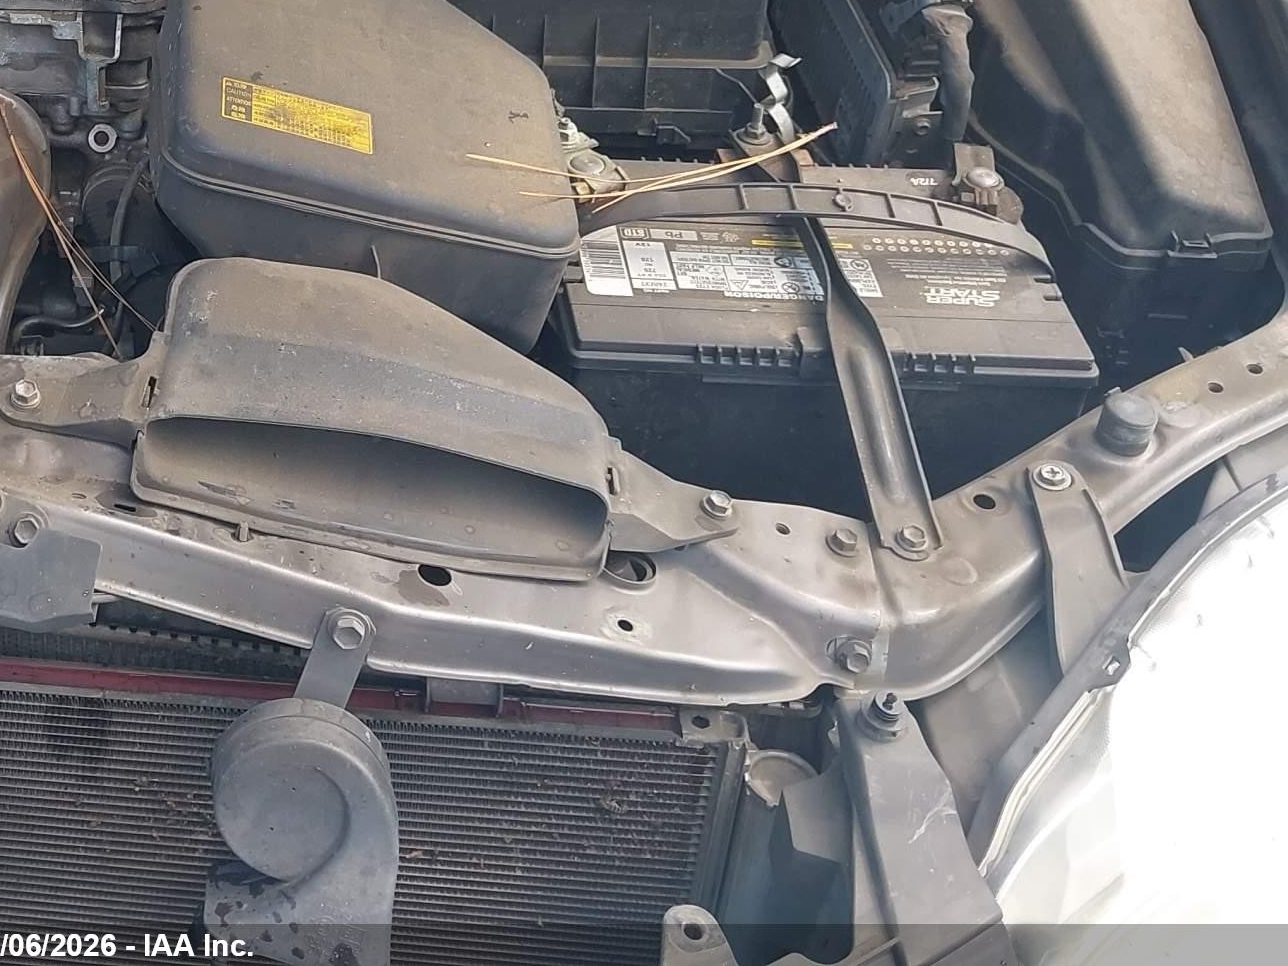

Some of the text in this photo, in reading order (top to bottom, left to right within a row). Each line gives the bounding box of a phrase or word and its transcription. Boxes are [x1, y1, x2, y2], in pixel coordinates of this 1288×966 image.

[665, 231, 683, 239] Pb
[924, 287, 1000, 302] START
[926, 295, 995, 308] SUPER
